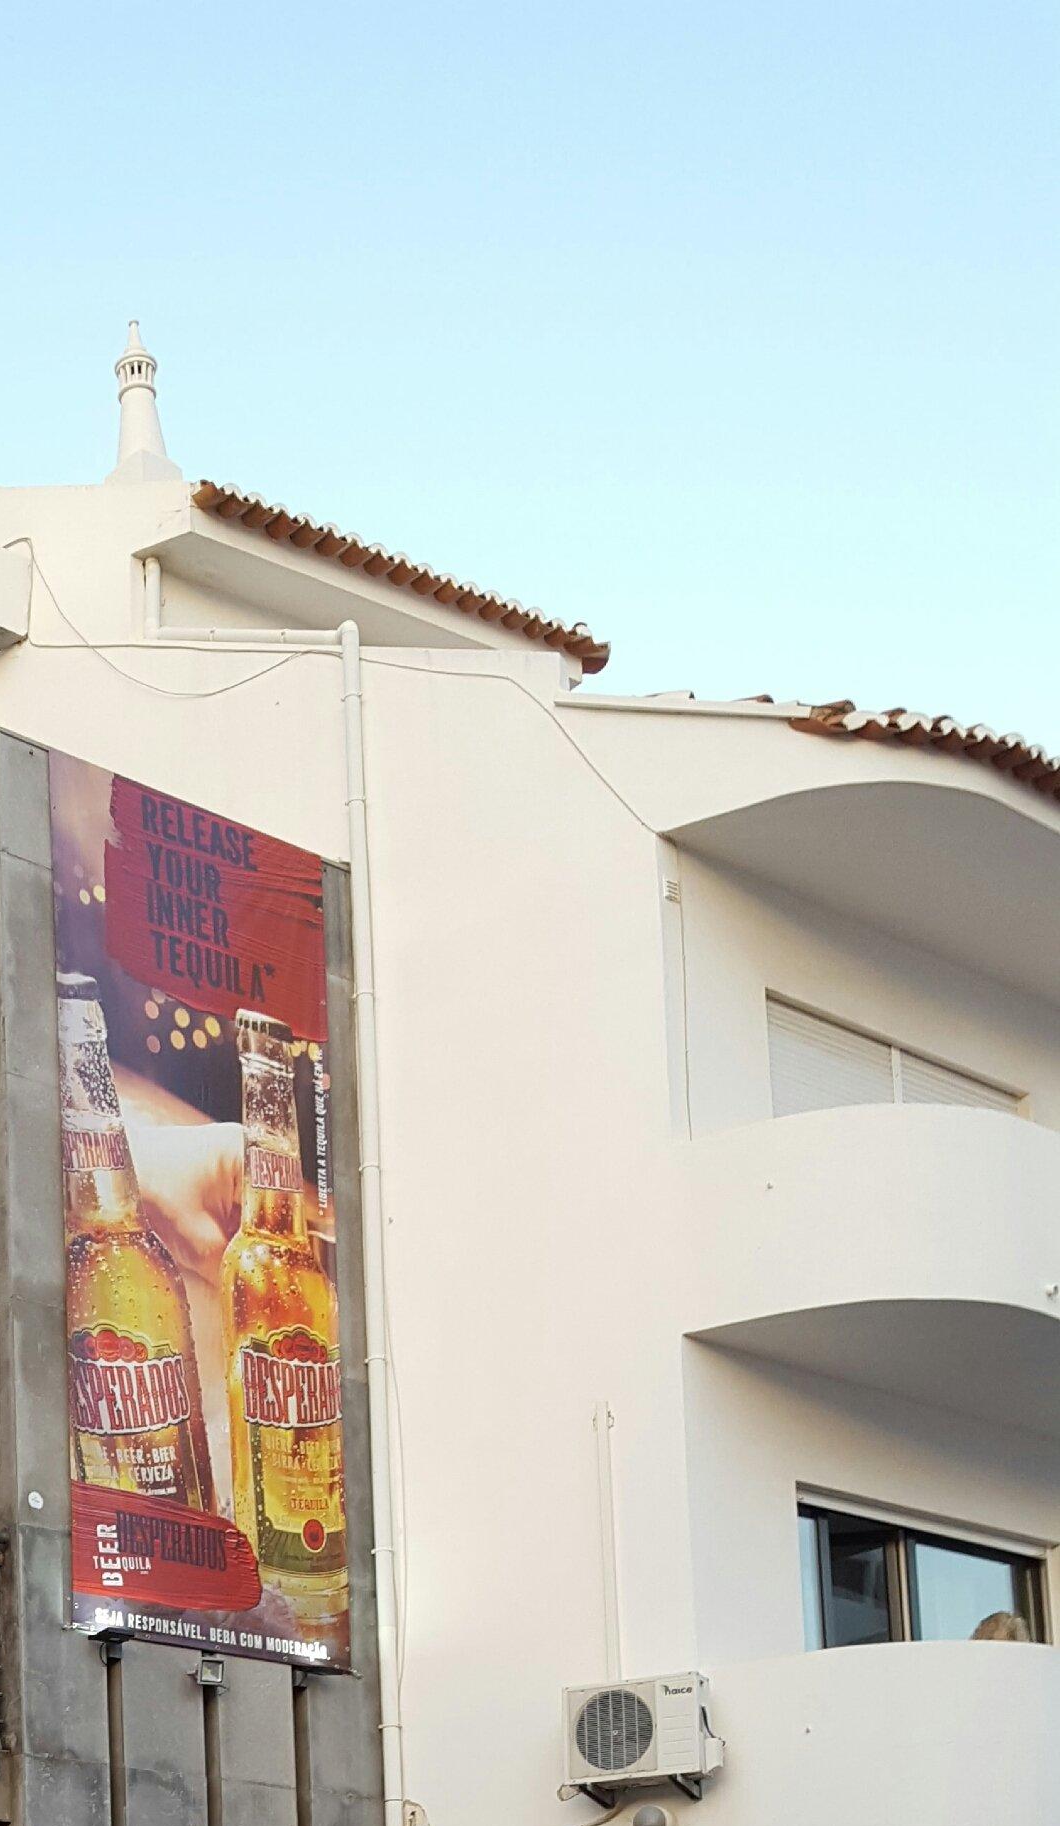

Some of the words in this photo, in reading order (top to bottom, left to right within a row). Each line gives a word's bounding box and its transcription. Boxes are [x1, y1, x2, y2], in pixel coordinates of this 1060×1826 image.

[142, 795, 257, 871] RELEASE
[147, 843, 222, 903] YOUR
[147, 884, 230, 948] INNER
[315, 1095, 326, 1115] QUE
[316, 1116, 327, 1156] TEQUILA
[318, 1167, 328, 1208] LIBERTA
[97, 1524, 124, 1587] BEER
[116, 1511, 227, 1572] DESPERADOS
[95, 1607, 124, 1627] SEJA
[128, 1613, 206, 1641] RESPONSÁVEL.
[210, 1630, 236, 1646] BEBA
[240, 1634, 263, 1649] COM
